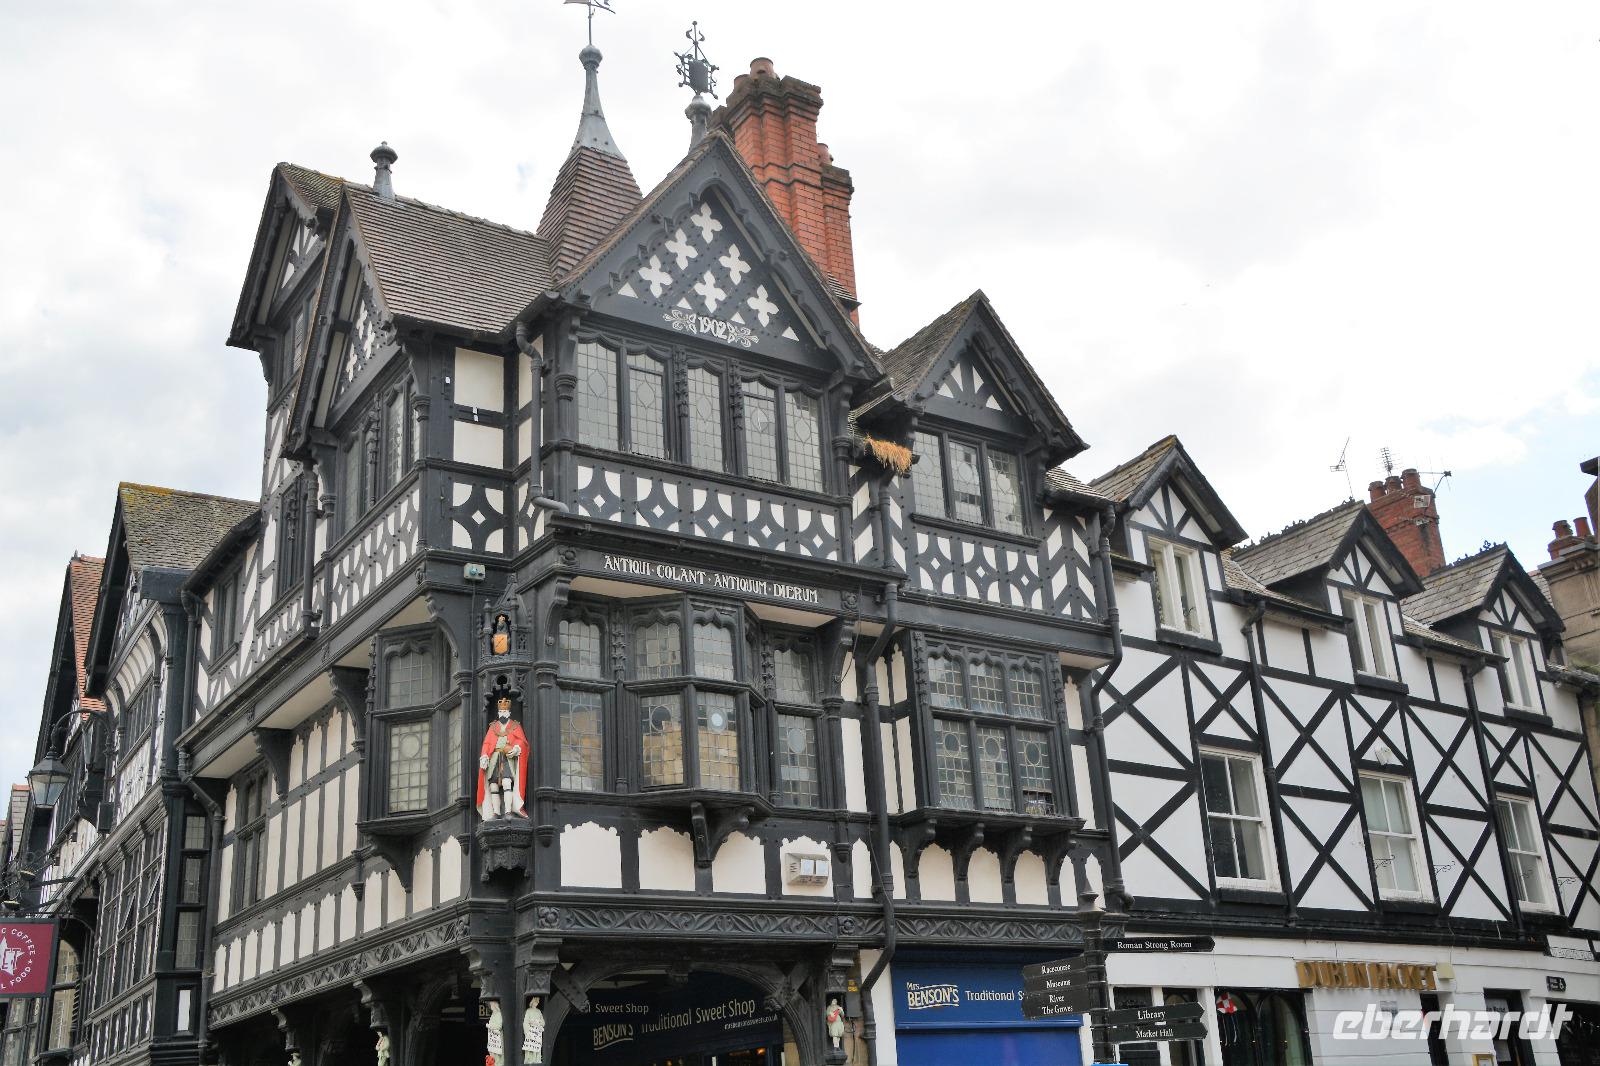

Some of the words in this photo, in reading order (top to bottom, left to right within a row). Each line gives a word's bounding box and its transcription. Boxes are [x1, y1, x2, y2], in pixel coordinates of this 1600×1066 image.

[698, 316, 728, 340] 1902
[656, 564, 706, 585] COLANT
[773, 583, 819, 604] DIERUM
[11, 928, 36, 956] COFFEE
[1117, 941, 1143, 950] Roman
[1145, 940, 1169, 951] Strong
[1170, 940, 1192, 949] Room
[10, 966, 31, 987] FOOD
[1296, 961, 1369, 988] DUBLIN
[907, 987, 960, 1007] BENSON'S
[965, 989, 1015, 1001] Traditional
[1049, 994, 1065, 1003] River
[595, 1003, 623, 1014] Sweet
[625, 1003, 649, 1015] Shop
[696, 1003, 727, 1024] Sweet
[728, 998, 756, 1018] Shop
[1042, 1005, 1054, 1015] The
[1054, 1004, 1073, 1014] Groves
[1137, 1009, 1166, 1021] Library
[1136, 1029, 1158, 1039] Market
[1159, 1028, 1174, 1038] Hall
